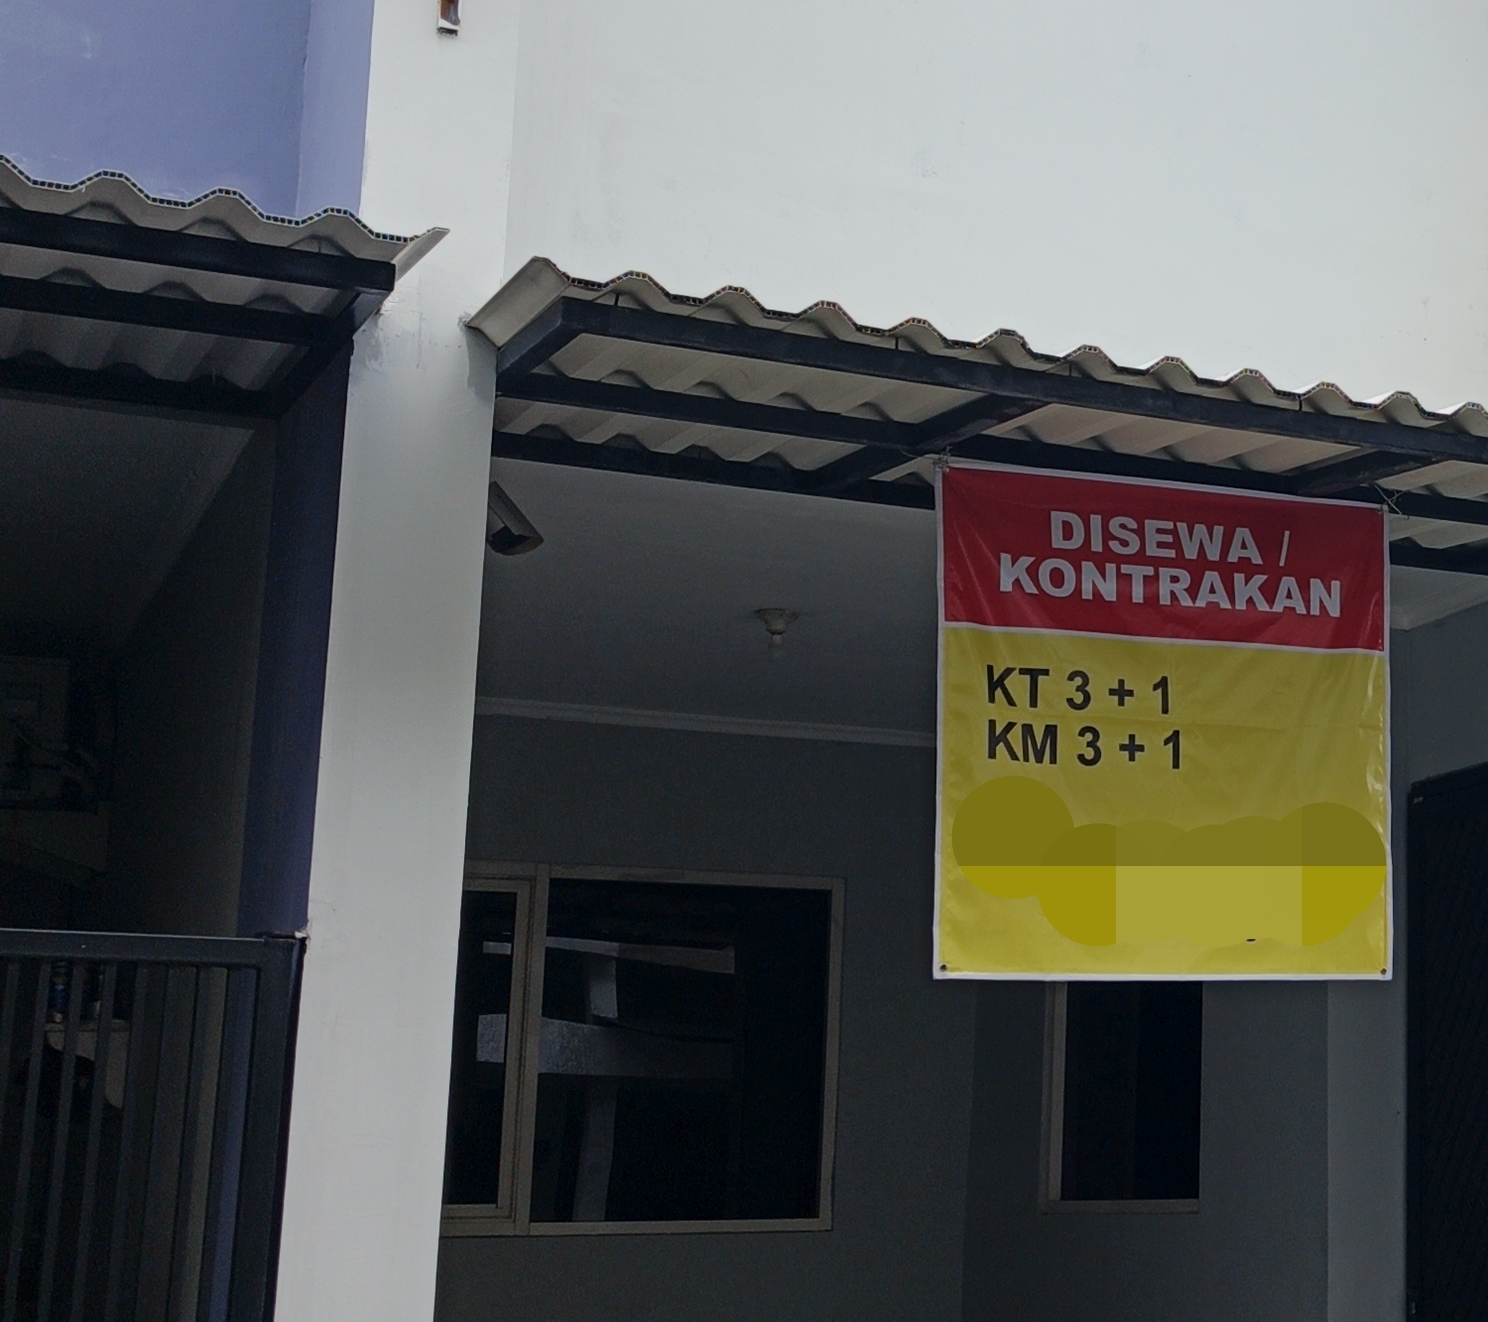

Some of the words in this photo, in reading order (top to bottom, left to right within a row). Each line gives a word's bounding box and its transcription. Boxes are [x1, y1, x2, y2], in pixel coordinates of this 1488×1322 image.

[1050, 510, 1264, 565] DISEWA
[1278, 530, 1291, 567] /
[999, 552, 1341, 618] KONTRAKAN
[985, 663, 1051, 709] KT
[1065, 669, 1092, 711] 3
[1108, 678, 1135, 707] +
[1152, 675, 1170, 715] 1
[987, 718, 1058, 765] KM
[1076, 725, 1102, 767] 3
[1118, 733, 1145, 762] +
[1163, 729, 1181, 770] 1
